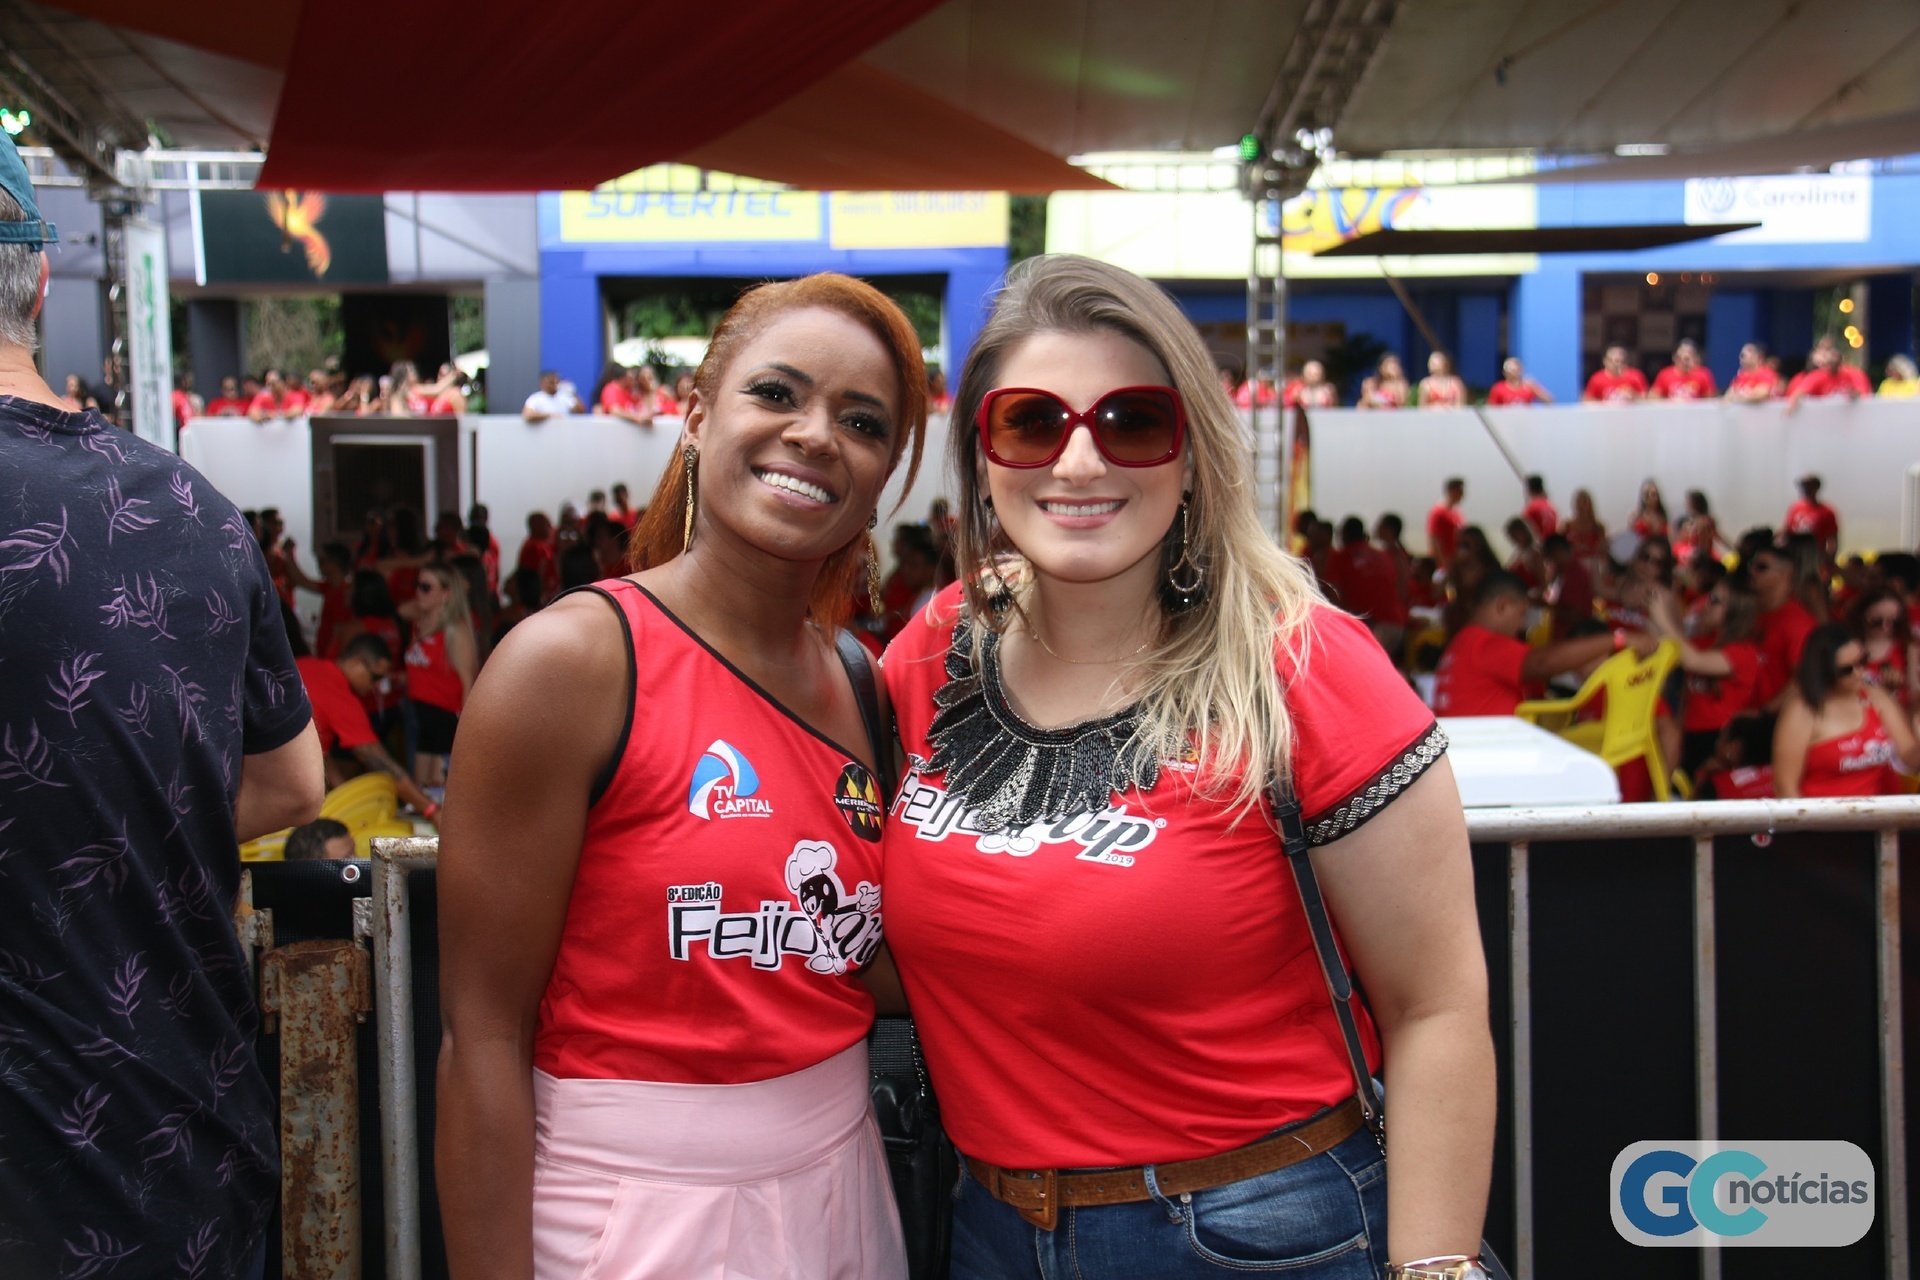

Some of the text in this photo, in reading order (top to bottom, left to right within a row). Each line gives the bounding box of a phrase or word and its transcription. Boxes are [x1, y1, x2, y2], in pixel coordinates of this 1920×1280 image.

[583, 191, 791, 217] SUPERTEC
[1744, 184, 1855, 208] Carolina
[713, 785, 734, 799] TV
[713, 798, 774, 814] CAPITAL
[1104, 854, 1134, 865] 2019
[681, 883, 721, 901] EDIÇÃO
